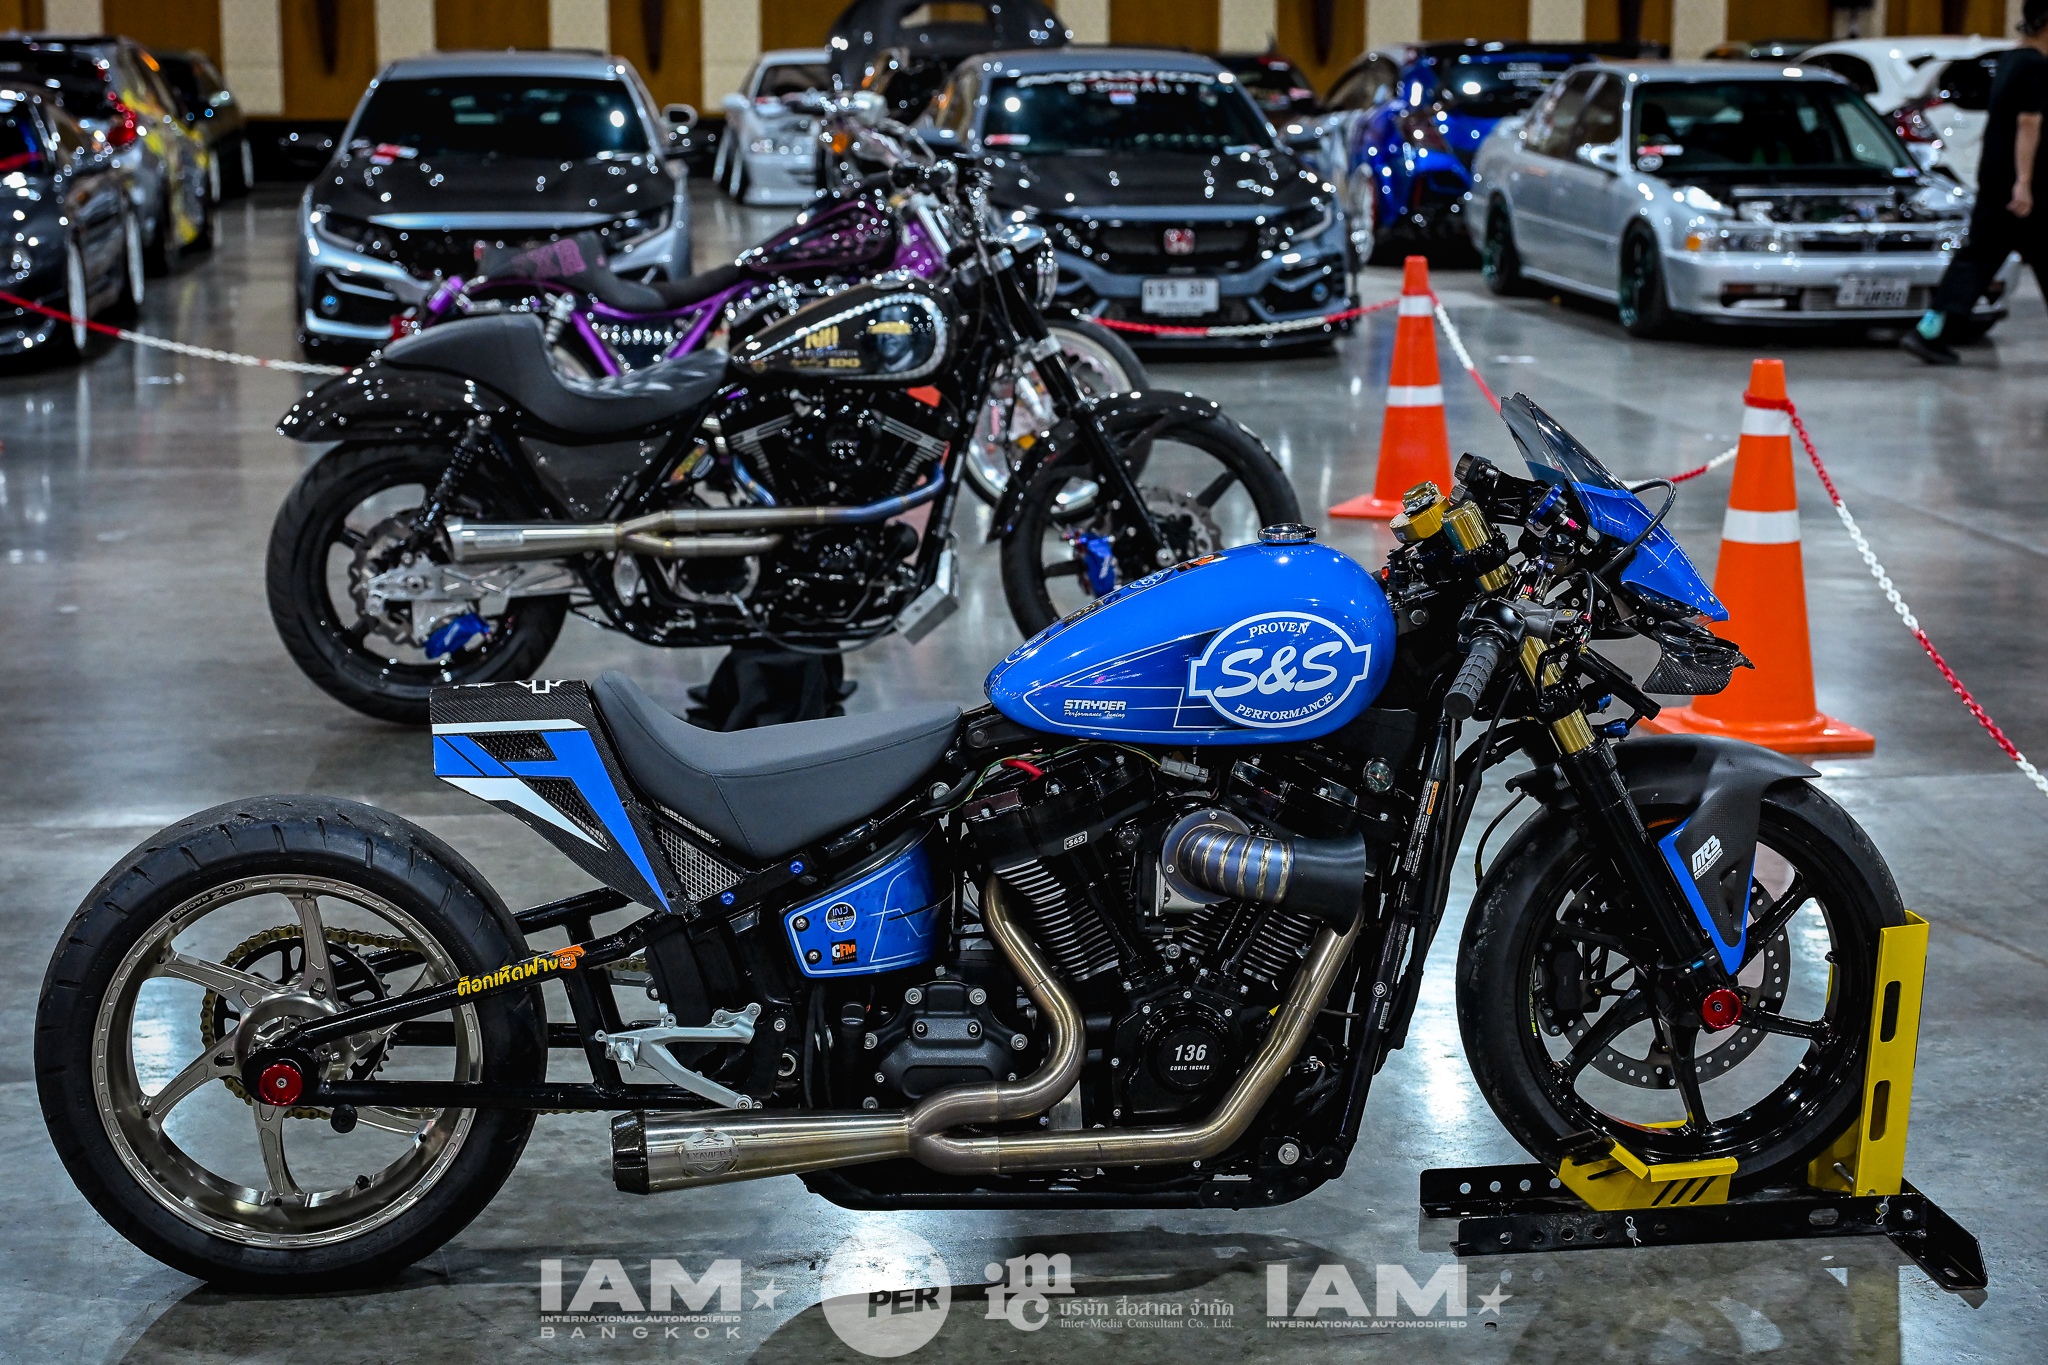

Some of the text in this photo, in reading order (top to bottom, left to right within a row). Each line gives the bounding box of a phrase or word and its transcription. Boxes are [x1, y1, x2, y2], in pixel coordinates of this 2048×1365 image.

[1249, 621, 1311, 639] PROVEN
[1213, 641, 1343, 698] S&S
[1063, 699, 1127, 711] STRYDER
[1064, 709, 1126, 719] Performance Tuning
[1234, 692, 1335, 721] PERFORMANCE
[172, 895, 210, 919] RACING
[831, 943, 856, 959] CFM
[1174, 1044, 1208, 1062] 136
